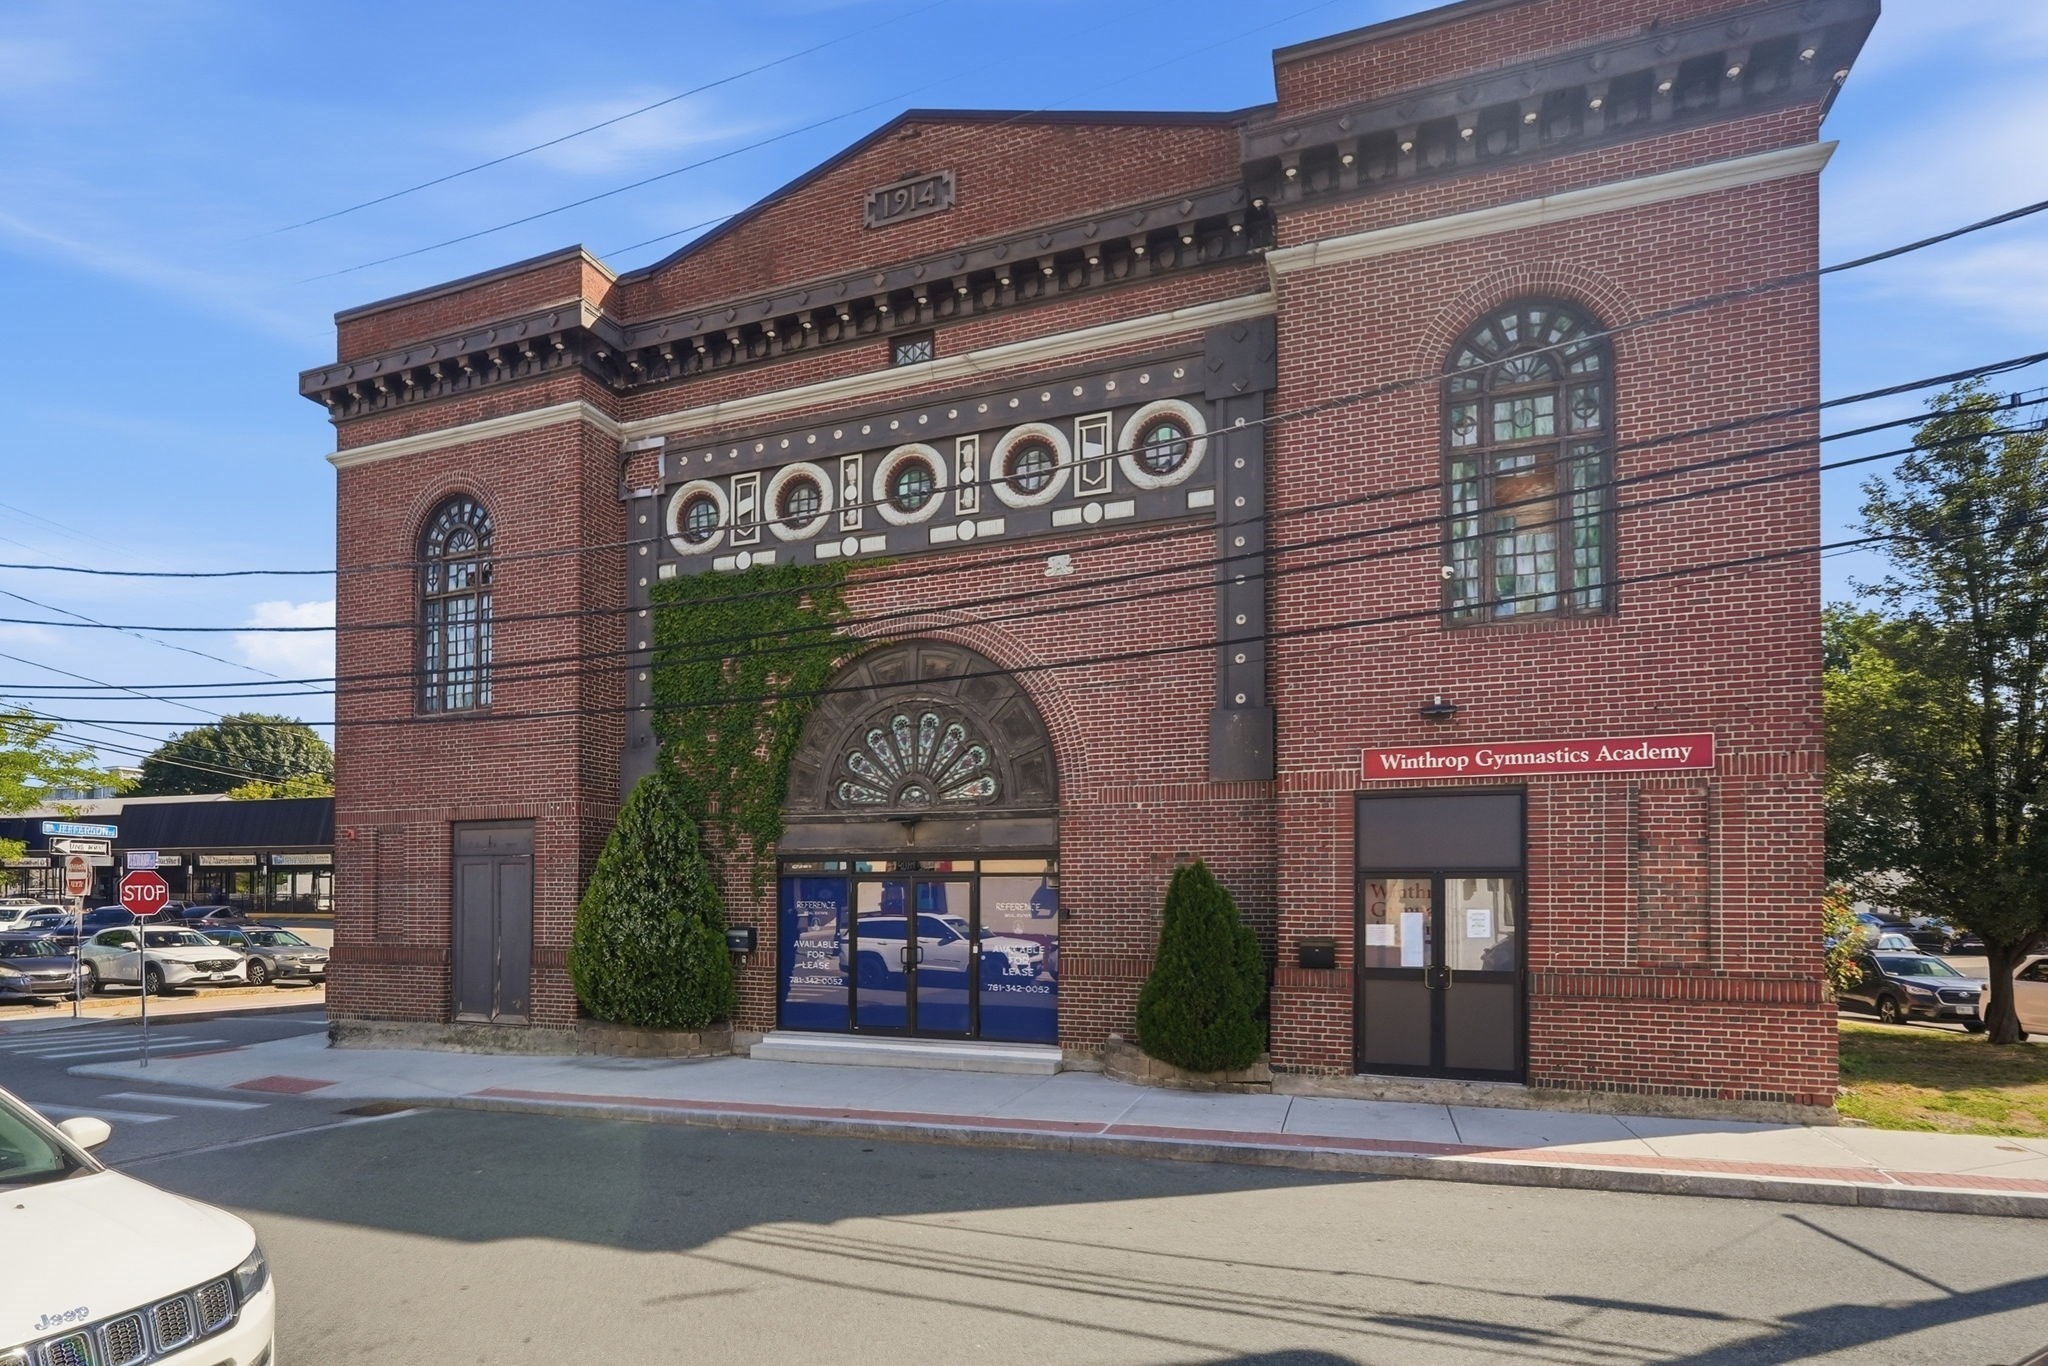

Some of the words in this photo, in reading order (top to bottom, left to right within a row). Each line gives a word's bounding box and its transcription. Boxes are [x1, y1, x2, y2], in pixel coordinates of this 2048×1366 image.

[882, 181, 936, 219] 1914
[1380, 752, 1469, 771] Winthrop
[1475, 747, 1590, 769] Gymnastics
[1595, 742, 1693, 763] Academy
[123, 885, 166, 901] STOP
[796, 900, 836, 910] REFERENCE
[995, 902, 1041, 911] REFERENCE
[793, 940, 839, 949] AVAILABLE
[807, 950, 825, 959] FOR
[802, 961, 830, 969] LEASE
[1002, 967, 1034, 976] LEASE
[987, 983, 1050, 993] 781-342-0052
[34, 1306, 89, 1330] Jeep
